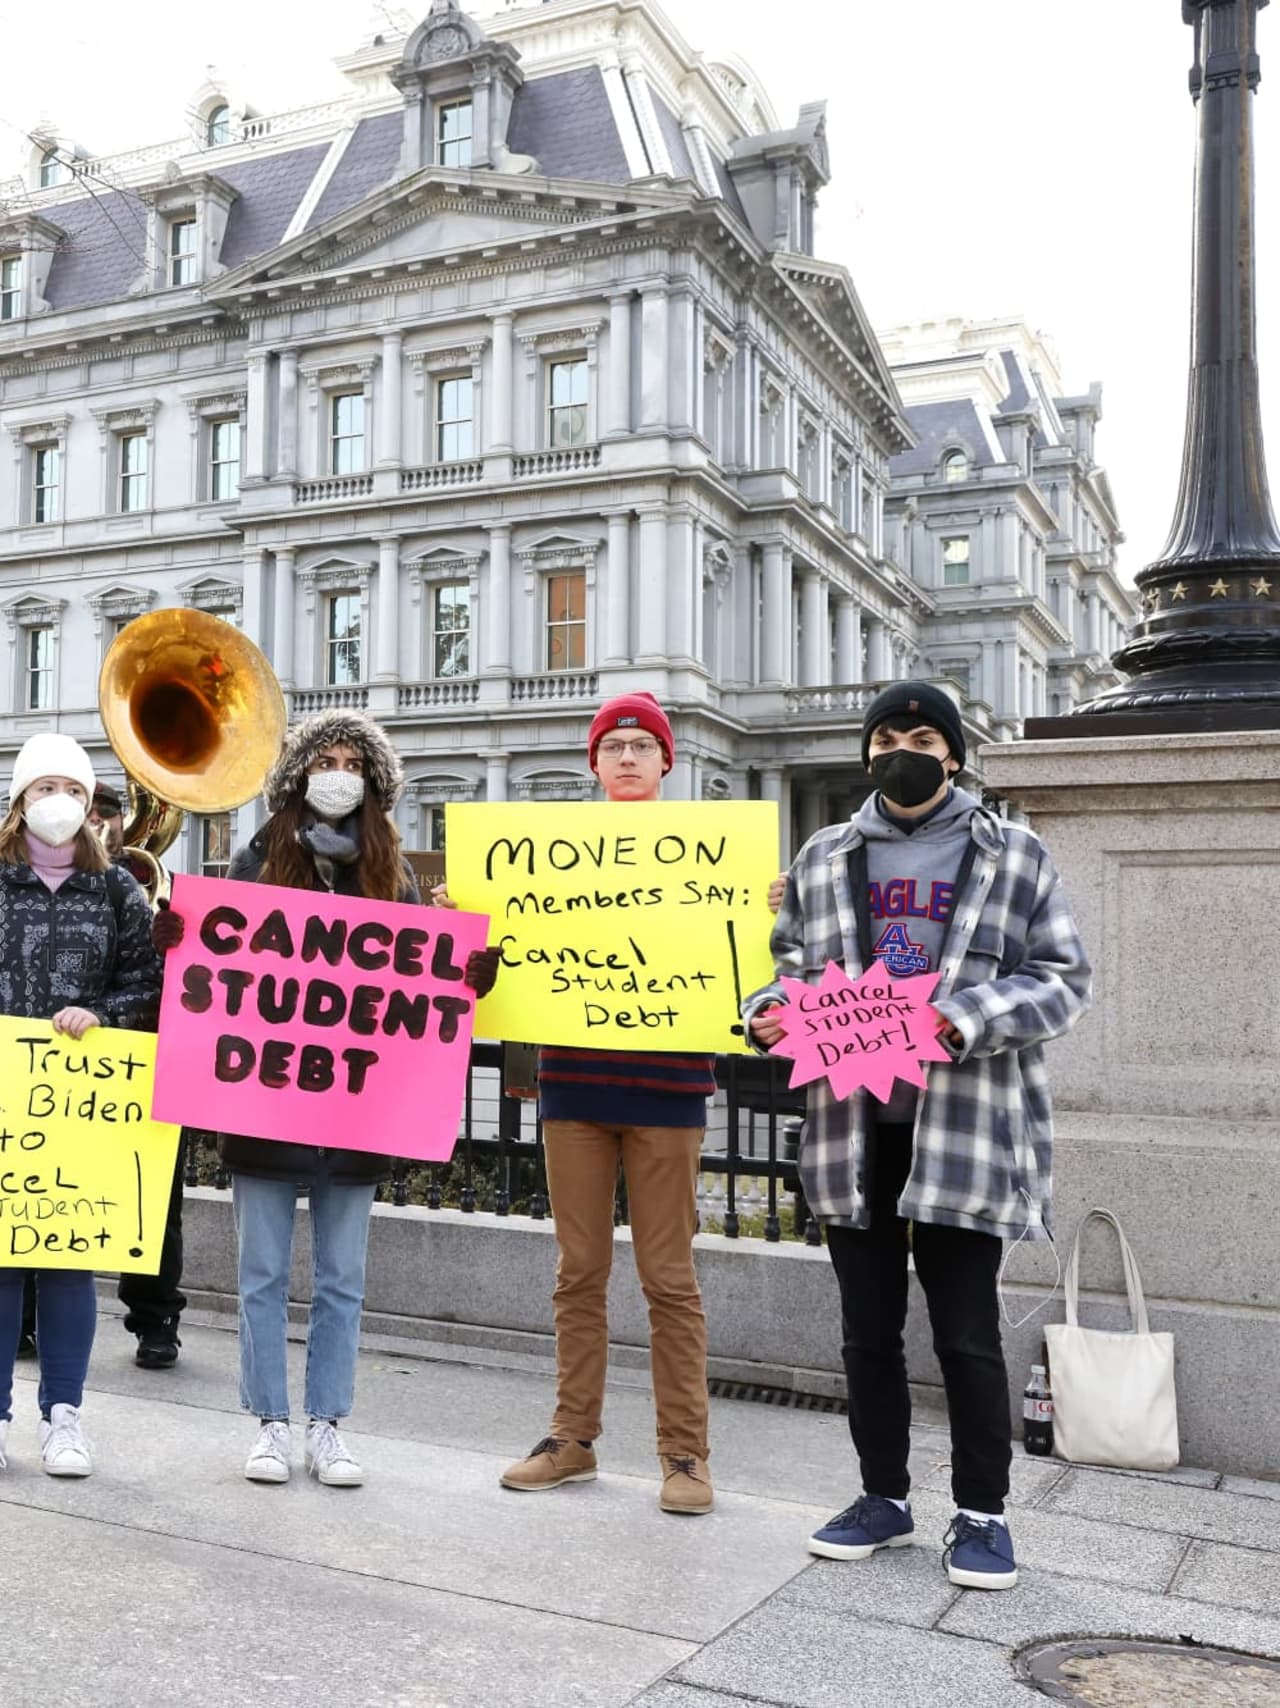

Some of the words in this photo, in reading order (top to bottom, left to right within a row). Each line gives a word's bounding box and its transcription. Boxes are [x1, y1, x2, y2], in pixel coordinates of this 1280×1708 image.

[506, 886, 664, 920] Members
[199, 905, 464, 982] CANCEL
[498, 935, 648, 971] Cancel
[551, 968, 718, 995] Student
[180, 962, 471, 1044] STUDENT
[584, 1000, 681, 1030] Debt
[15, 1037, 148, 1081] Trust
[214, 1033, 380, 1095] DEBT
[27, 1083, 144, 1123] Biden
[9, 1224, 112, 1256] Debt
